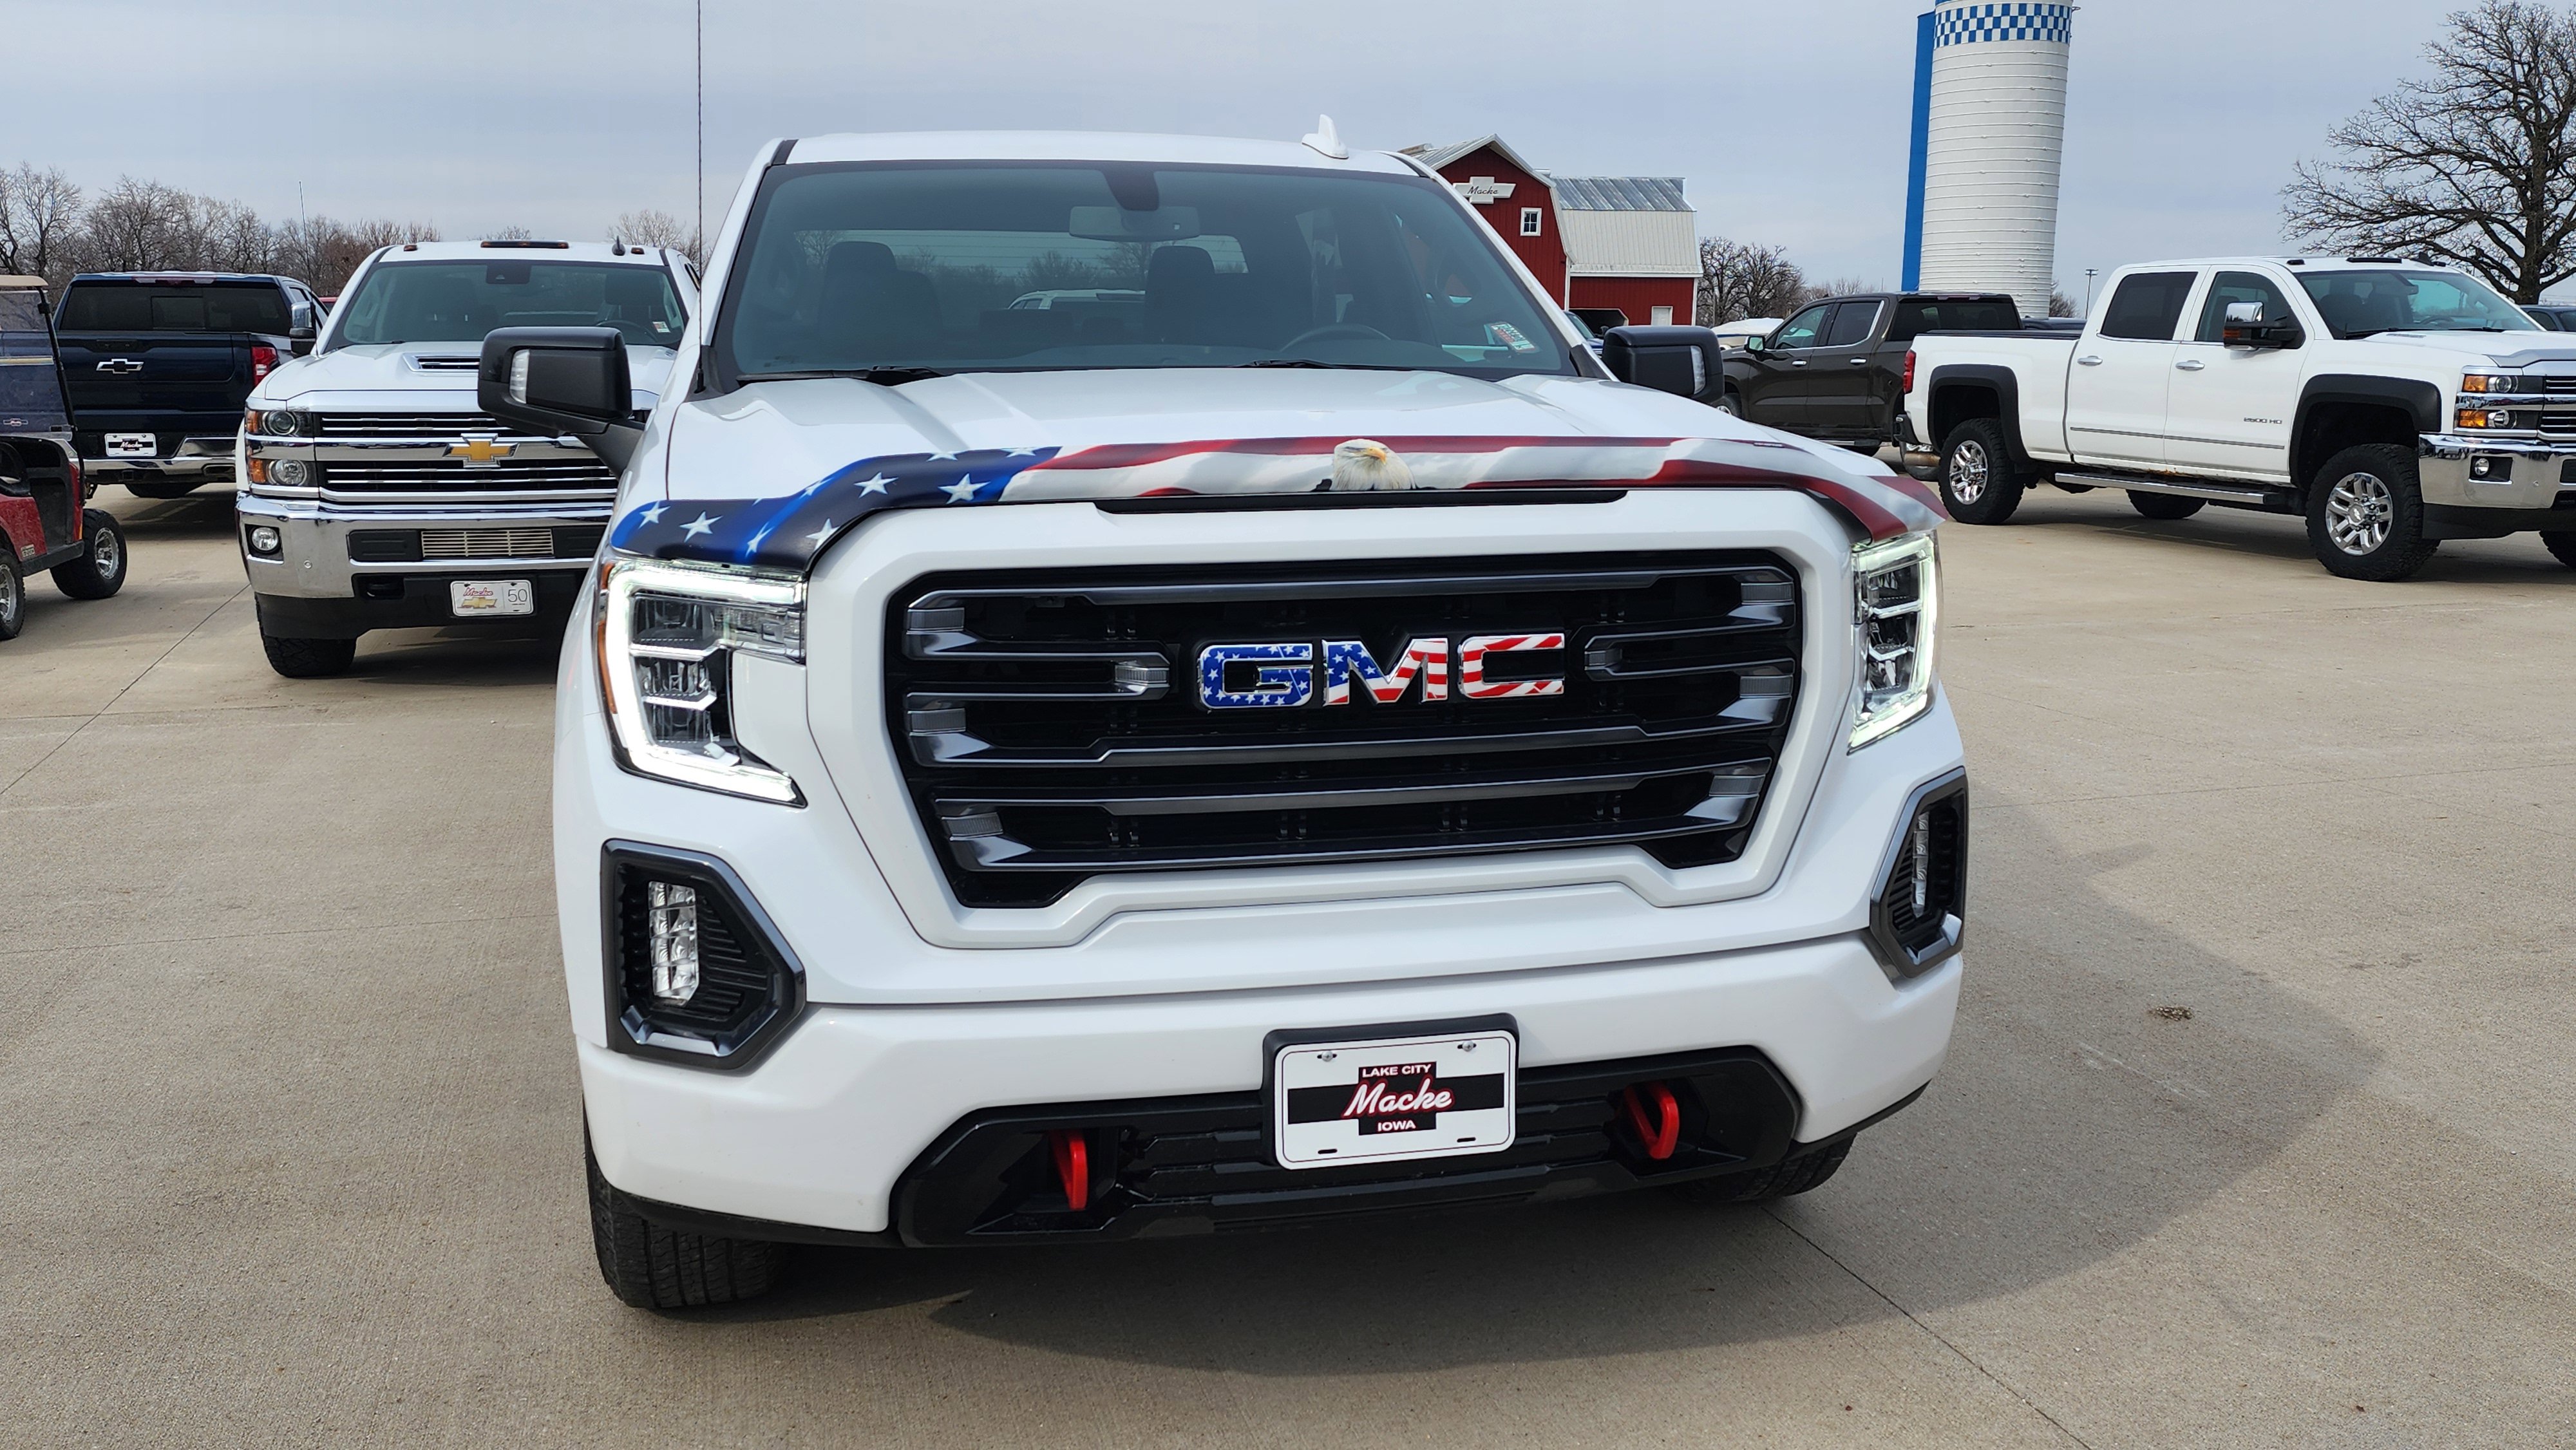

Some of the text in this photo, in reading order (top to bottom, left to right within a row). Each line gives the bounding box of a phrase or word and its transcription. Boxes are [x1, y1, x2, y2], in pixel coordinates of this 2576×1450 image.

[1467, 185, 1499, 194] Macke
[508, 588, 527, 603] 50
[1199, 633, 1565, 708] GMC
[1362, 1064, 1432, 1078] LAKE CITY
[1342, 1077, 1453, 1117] Macke
[1378, 1120, 1416, 1132] IOWA
